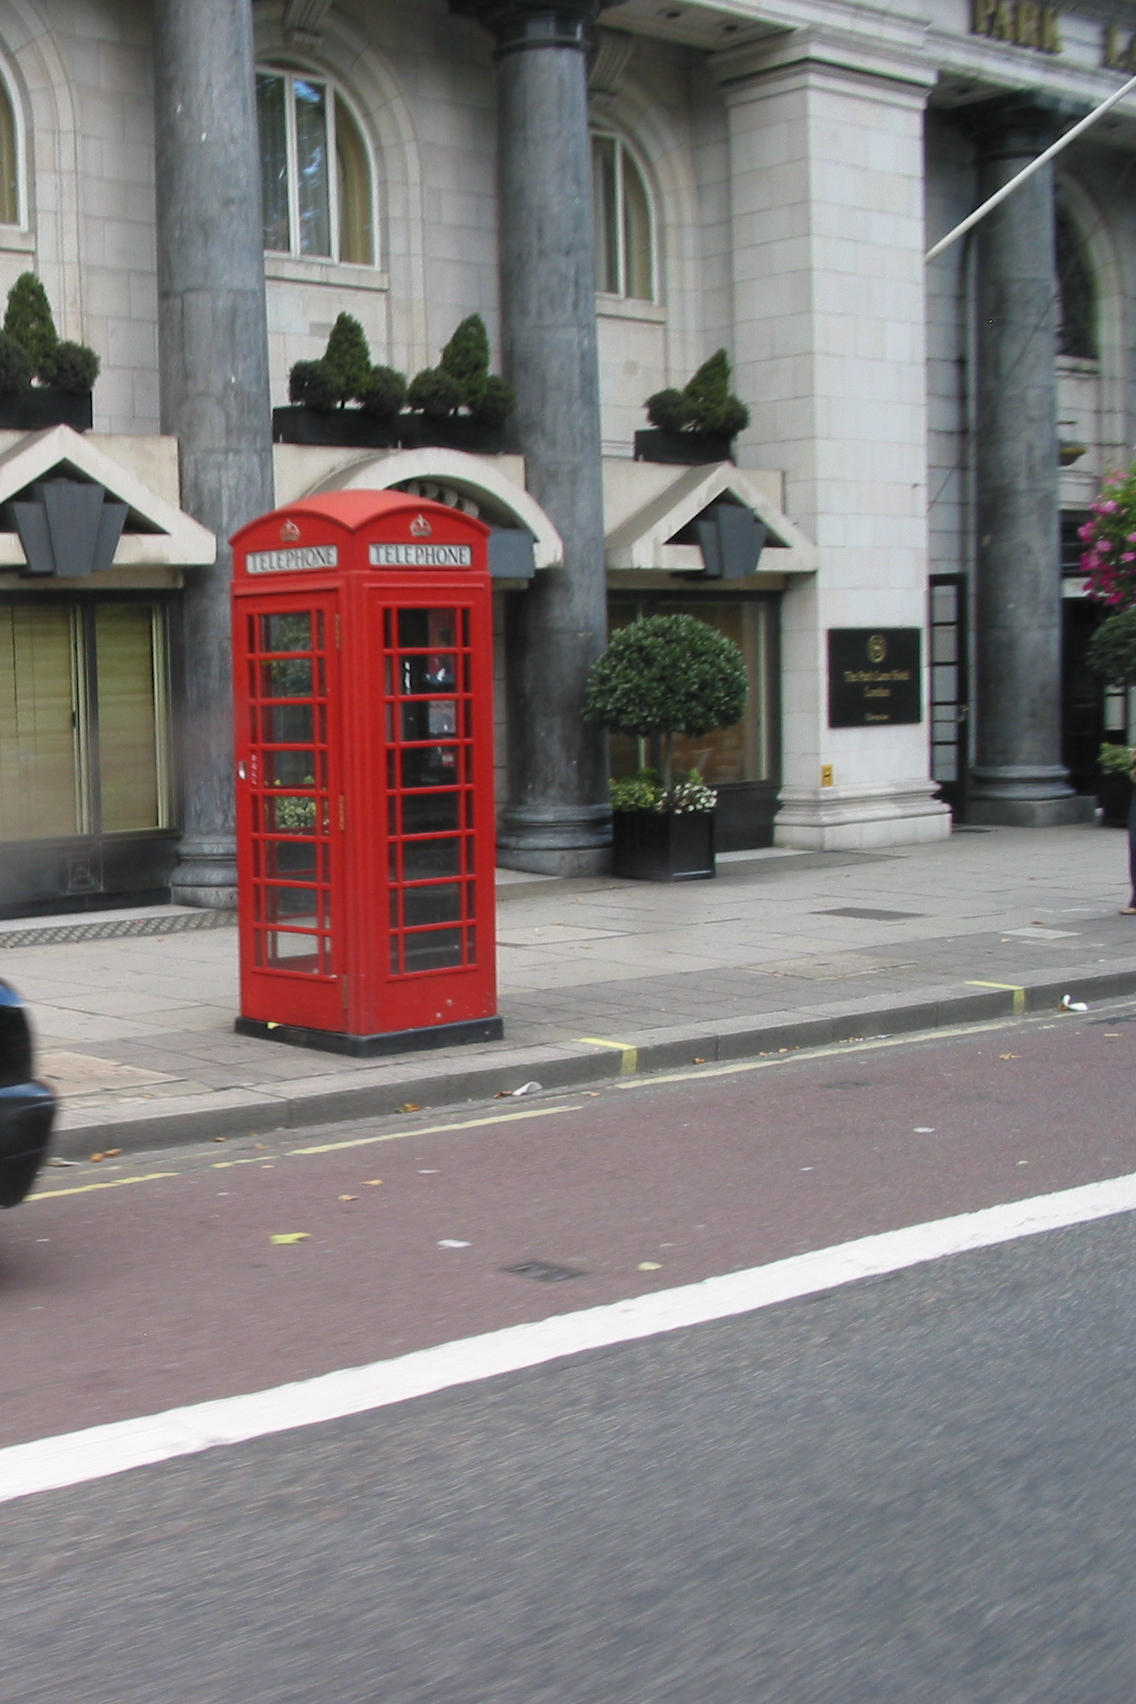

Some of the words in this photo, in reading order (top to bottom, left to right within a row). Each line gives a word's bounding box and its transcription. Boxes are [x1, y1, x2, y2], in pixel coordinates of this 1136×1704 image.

[970, 0, 1063, 54] PARK
[250, 546, 337, 572] TELEPHONE
[375, 545, 467, 565] TELEPHONE
